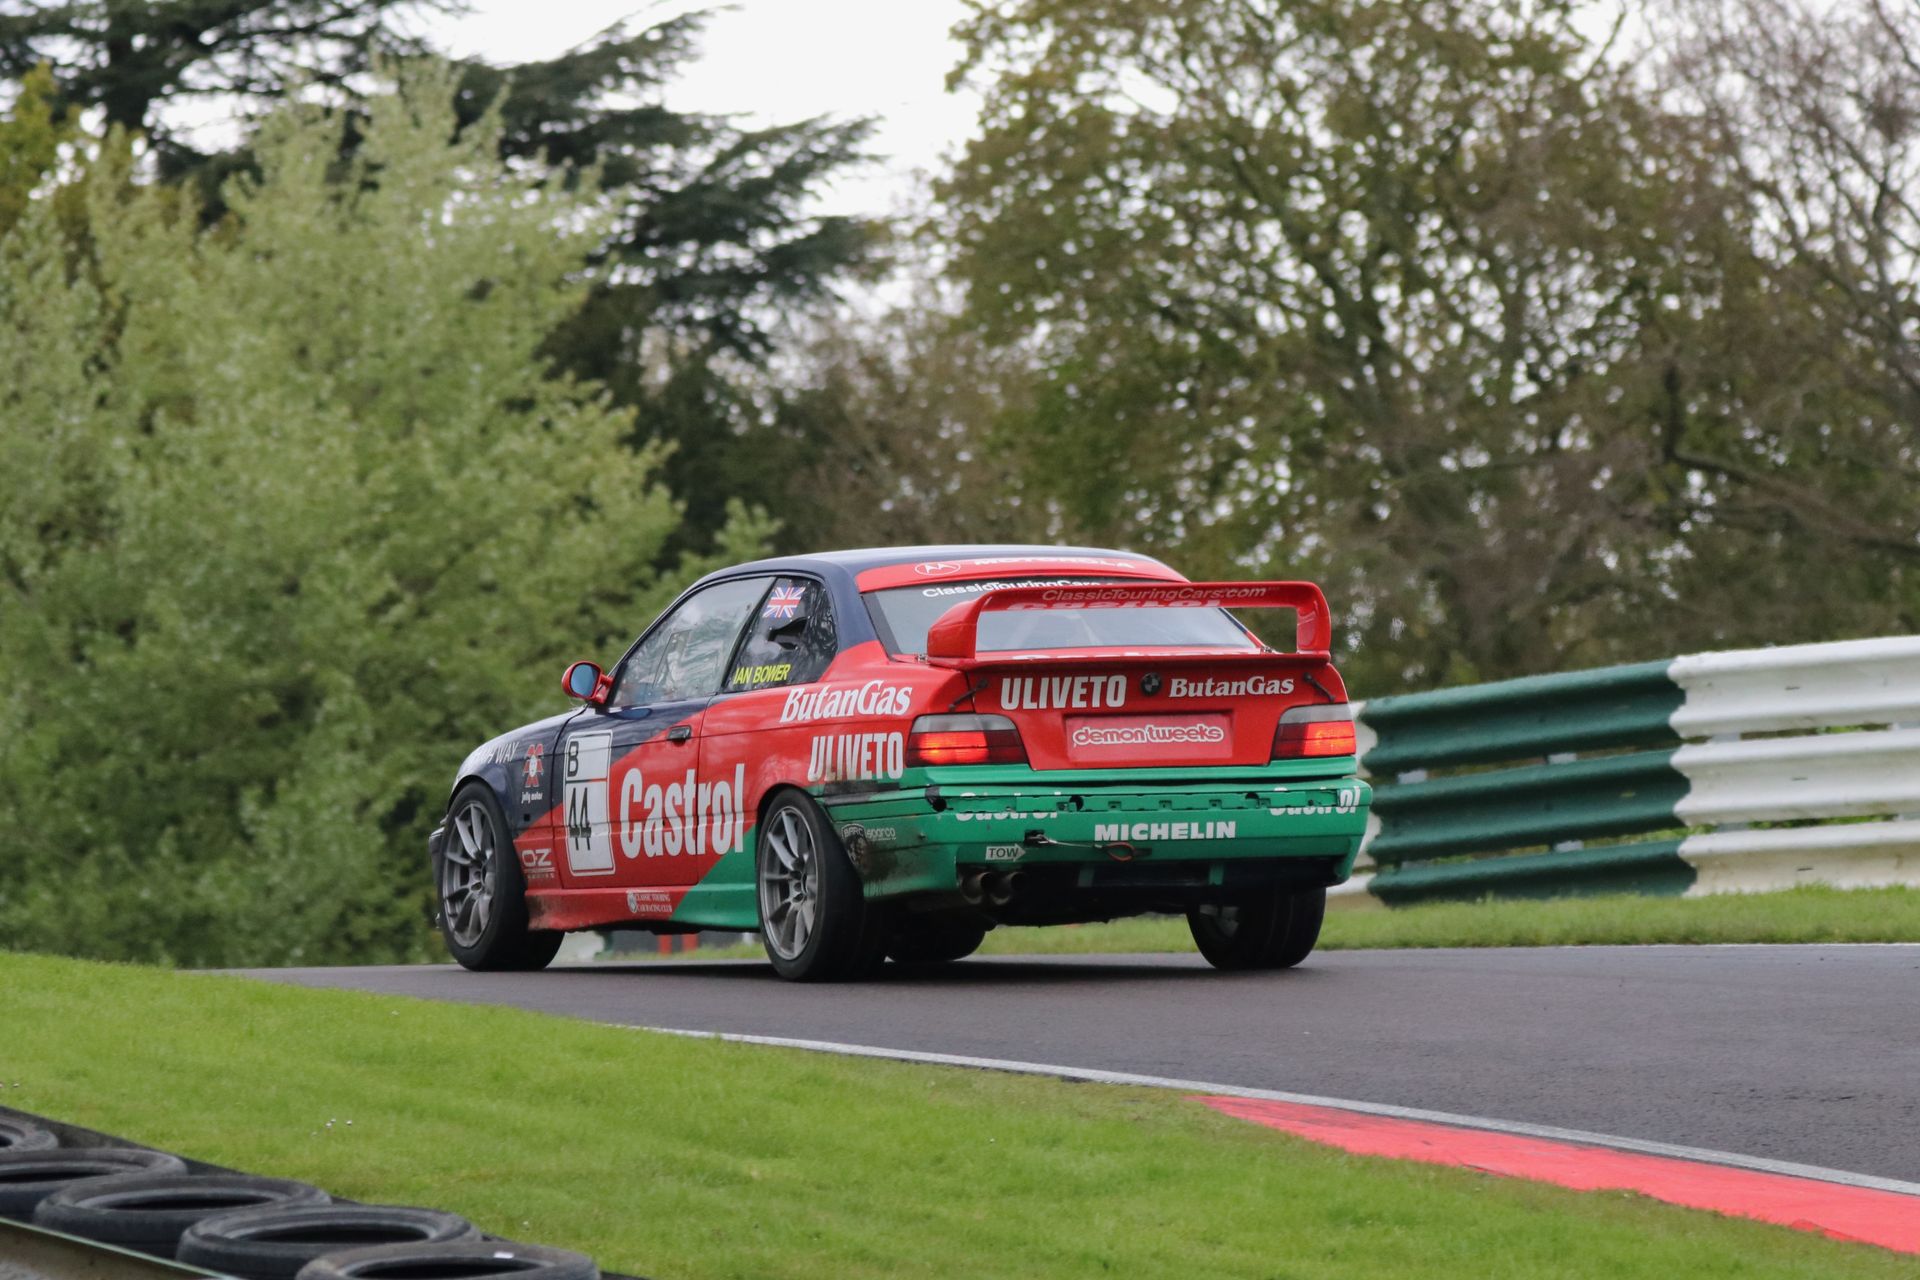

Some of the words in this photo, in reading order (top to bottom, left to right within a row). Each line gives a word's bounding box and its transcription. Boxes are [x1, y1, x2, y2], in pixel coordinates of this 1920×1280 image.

[1042, 587, 1267, 601] ClassicTouringCars.com
[733, 665, 752, 685] IAN
[752, 663, 791, 684] BOWER
[1000, 674, 1127, 710] ULIVETO
[1168, 675, 1295, 698] ButanGas
[780, 679, 912, 723] ButanGas
[1073, 727, 1145, 746] demon
[1146, 723, 1224, 744] tweeks
[567, 741, 579, 777] B
[807, 731, 904, 782] ULIVETO
[568, 787, 592, 851] 44
[620, 763, 745, 859] Castrol
[1094, 821, 1236, 841] MICHELIN
[521, 848, 553, 867] OZ
[988, 847, 1020, 859] TOW
